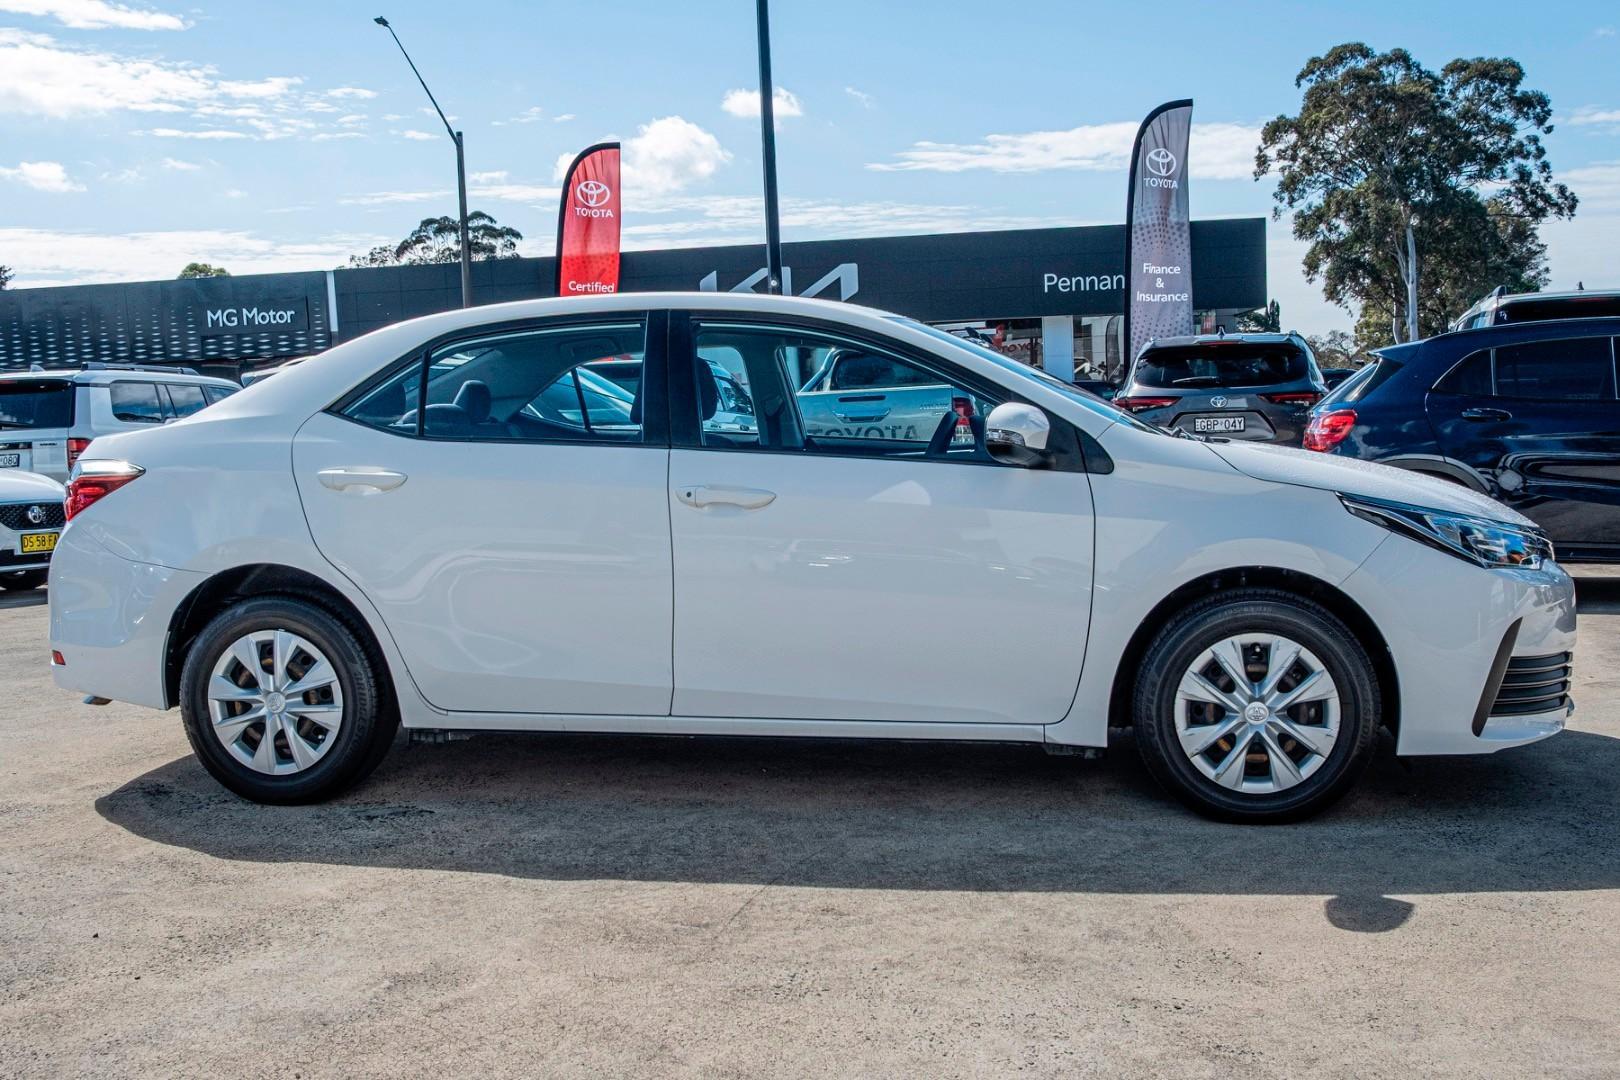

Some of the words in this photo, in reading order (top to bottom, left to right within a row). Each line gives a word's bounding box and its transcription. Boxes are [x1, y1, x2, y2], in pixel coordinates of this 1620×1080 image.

[1144, 178, 1178, 189] TOYOTA
[575, 208, 614, 218] TOYOTA
[1143, 263, 1181, 275] Finance
[568, 281, 615, 293] Certified
[1156, 277, 1165, 289] &
[1137, 291, 1189, 302] Insurance
[207, 309, 238, 328] MG
[242, 307, 295, 326] Motor
[1200, 420, 1218, 431] GBP
[1224, 418, 1243, 430] 04Y
[23, 536, 34, 548] DS
[36, 535, 46, 547] 58
